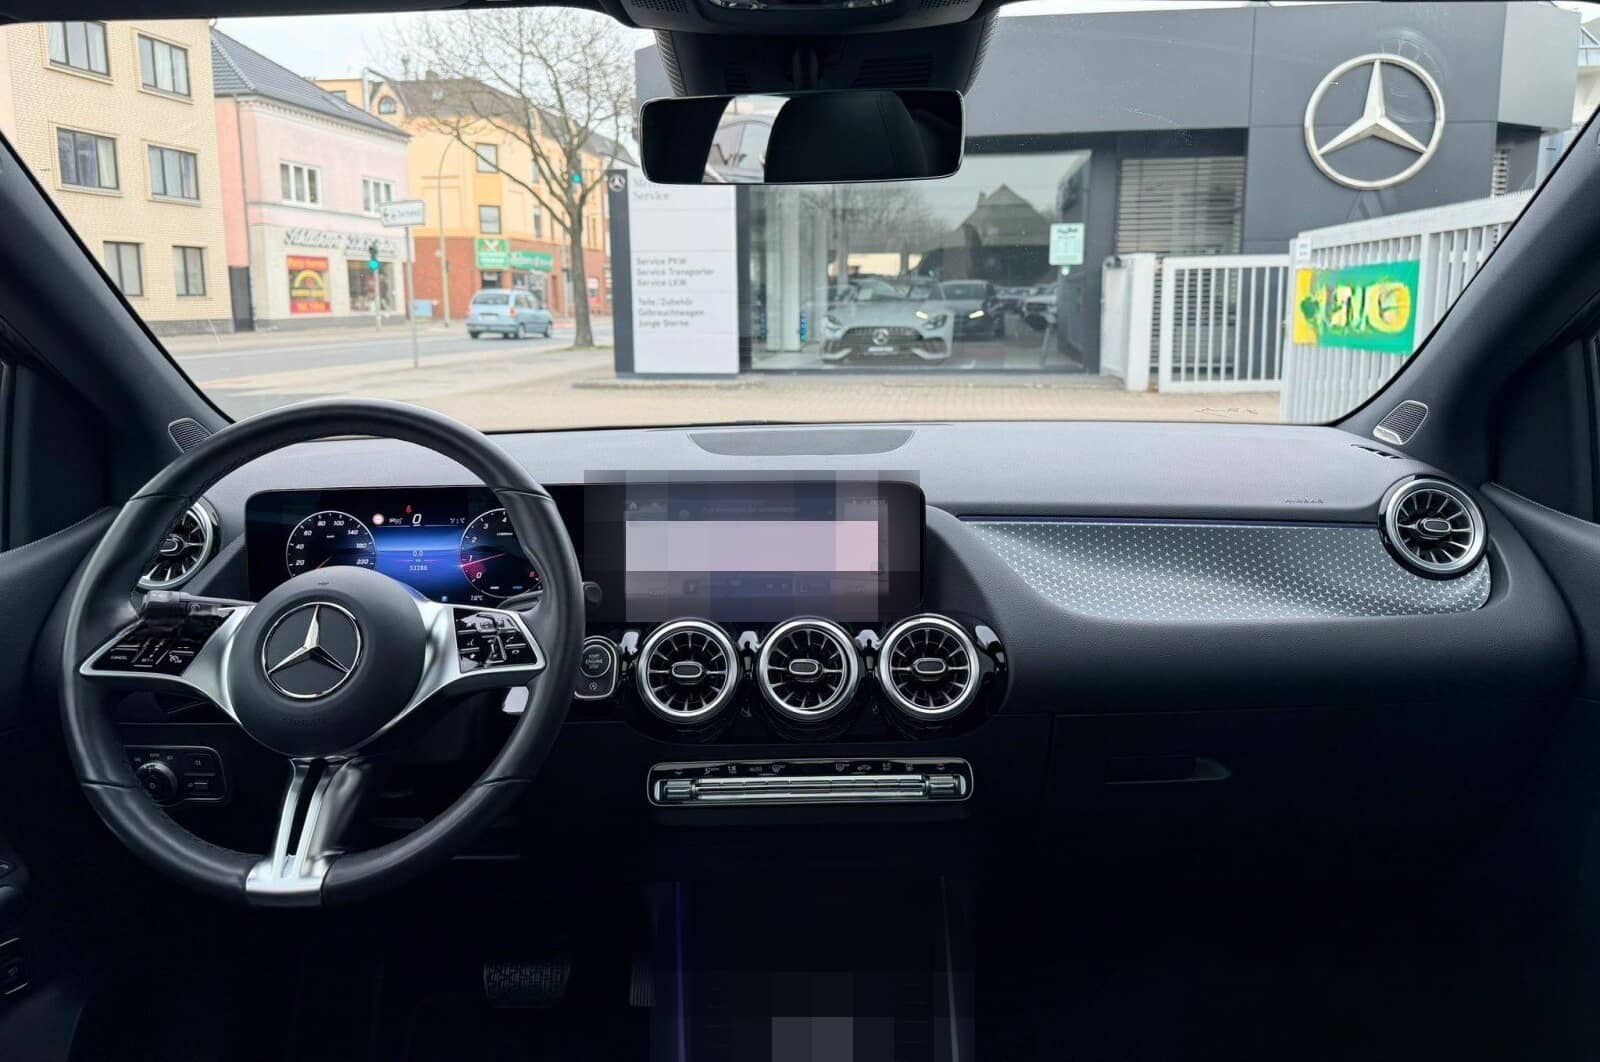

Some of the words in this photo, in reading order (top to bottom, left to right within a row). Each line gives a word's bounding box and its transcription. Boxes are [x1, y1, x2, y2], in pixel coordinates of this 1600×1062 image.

[633, 190, 670, 201] Service
[636, 257, 665, 266] Service
[636, 267, 666, 276] Service
[669, 267, 714, 278] Transporter
[636, 278, 666, 287] Service
[638, 307, 705, 318] Gebrauchtwagen
[638, 318, 661, 328] Junge
[411, 513, 422, 525] 0
[475, 571, 483, 579] 0
